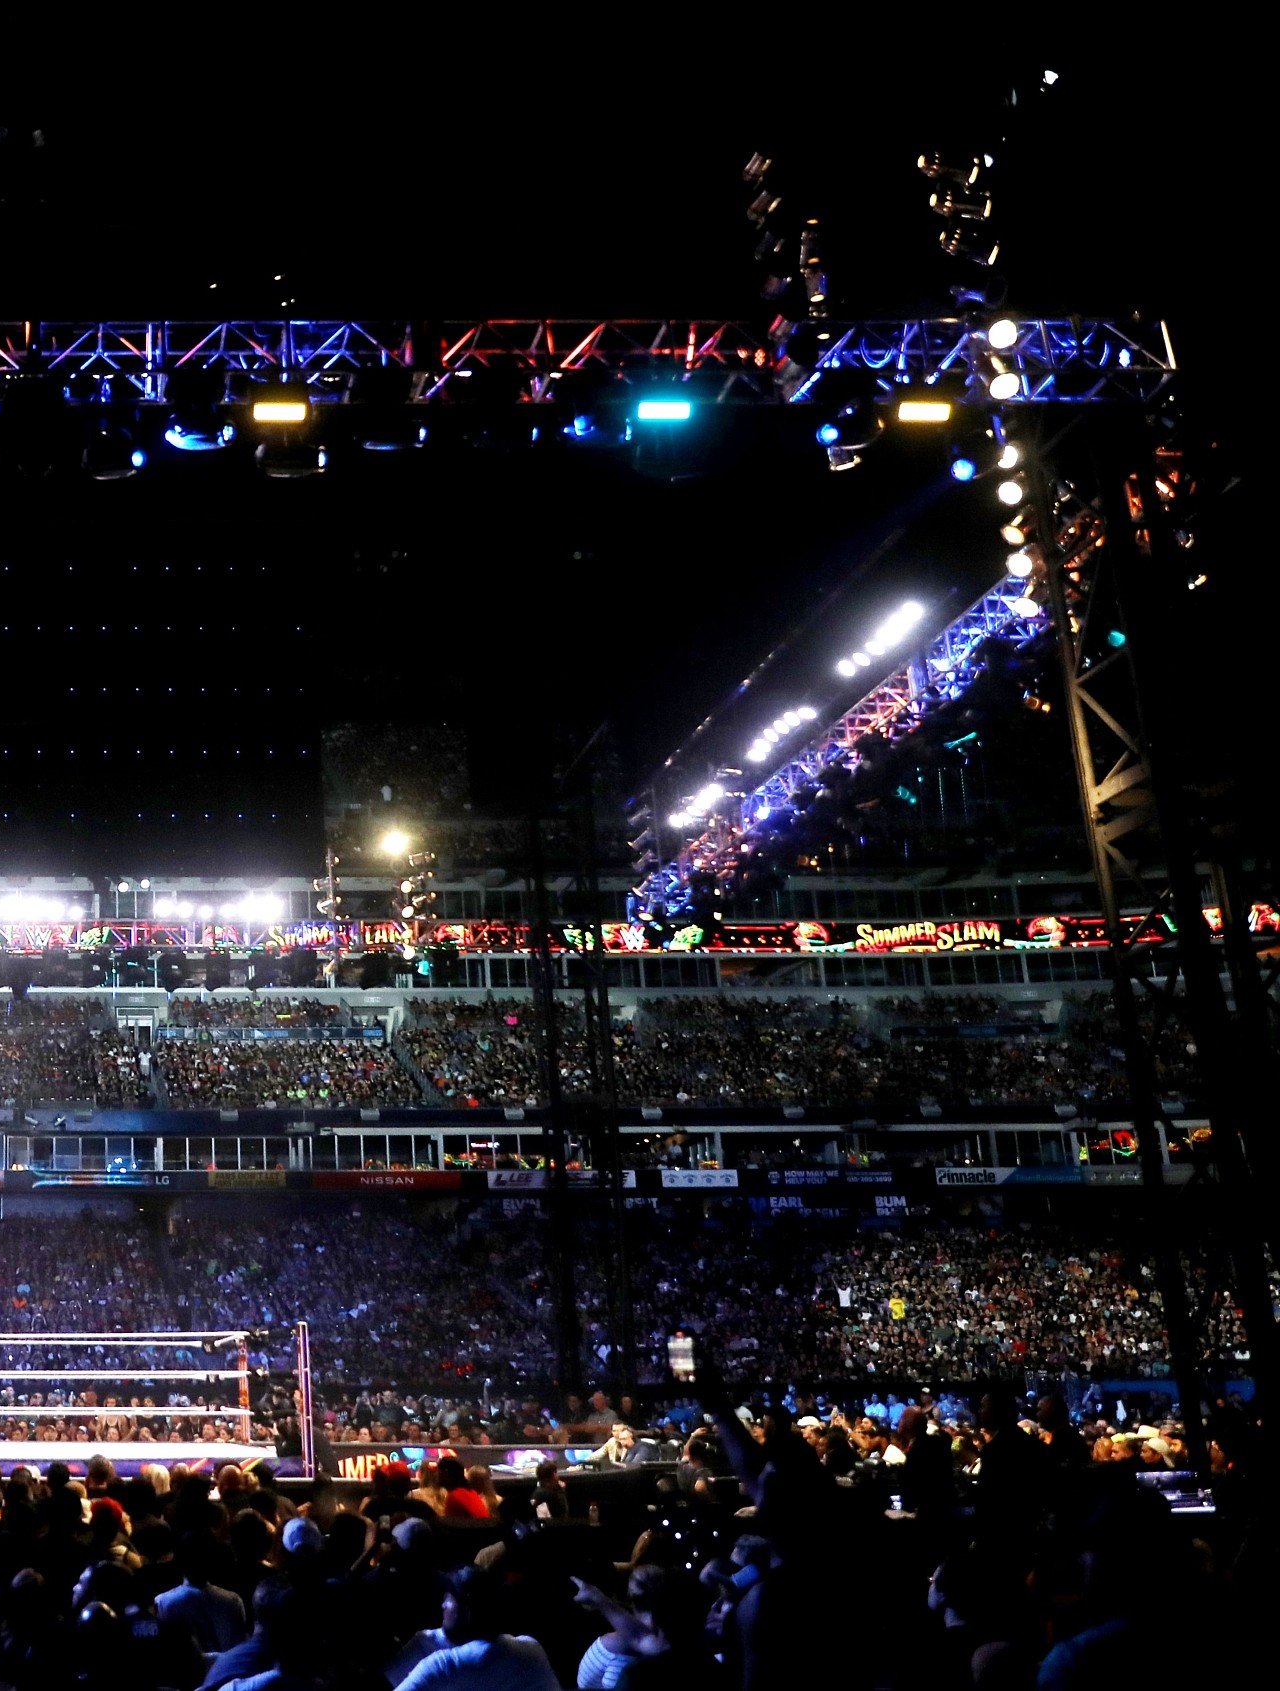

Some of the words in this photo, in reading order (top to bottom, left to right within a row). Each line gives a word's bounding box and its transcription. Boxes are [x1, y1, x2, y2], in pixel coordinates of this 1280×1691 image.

[155, 1175, 170, 1185] LG
[360, 1176, 414, 1185] NISSAN
[938, 1169, 996, 1183] Pinnacle
[769, 1196, 805, 1208] EARL
[874, 1195, 907, 1207] BUM
